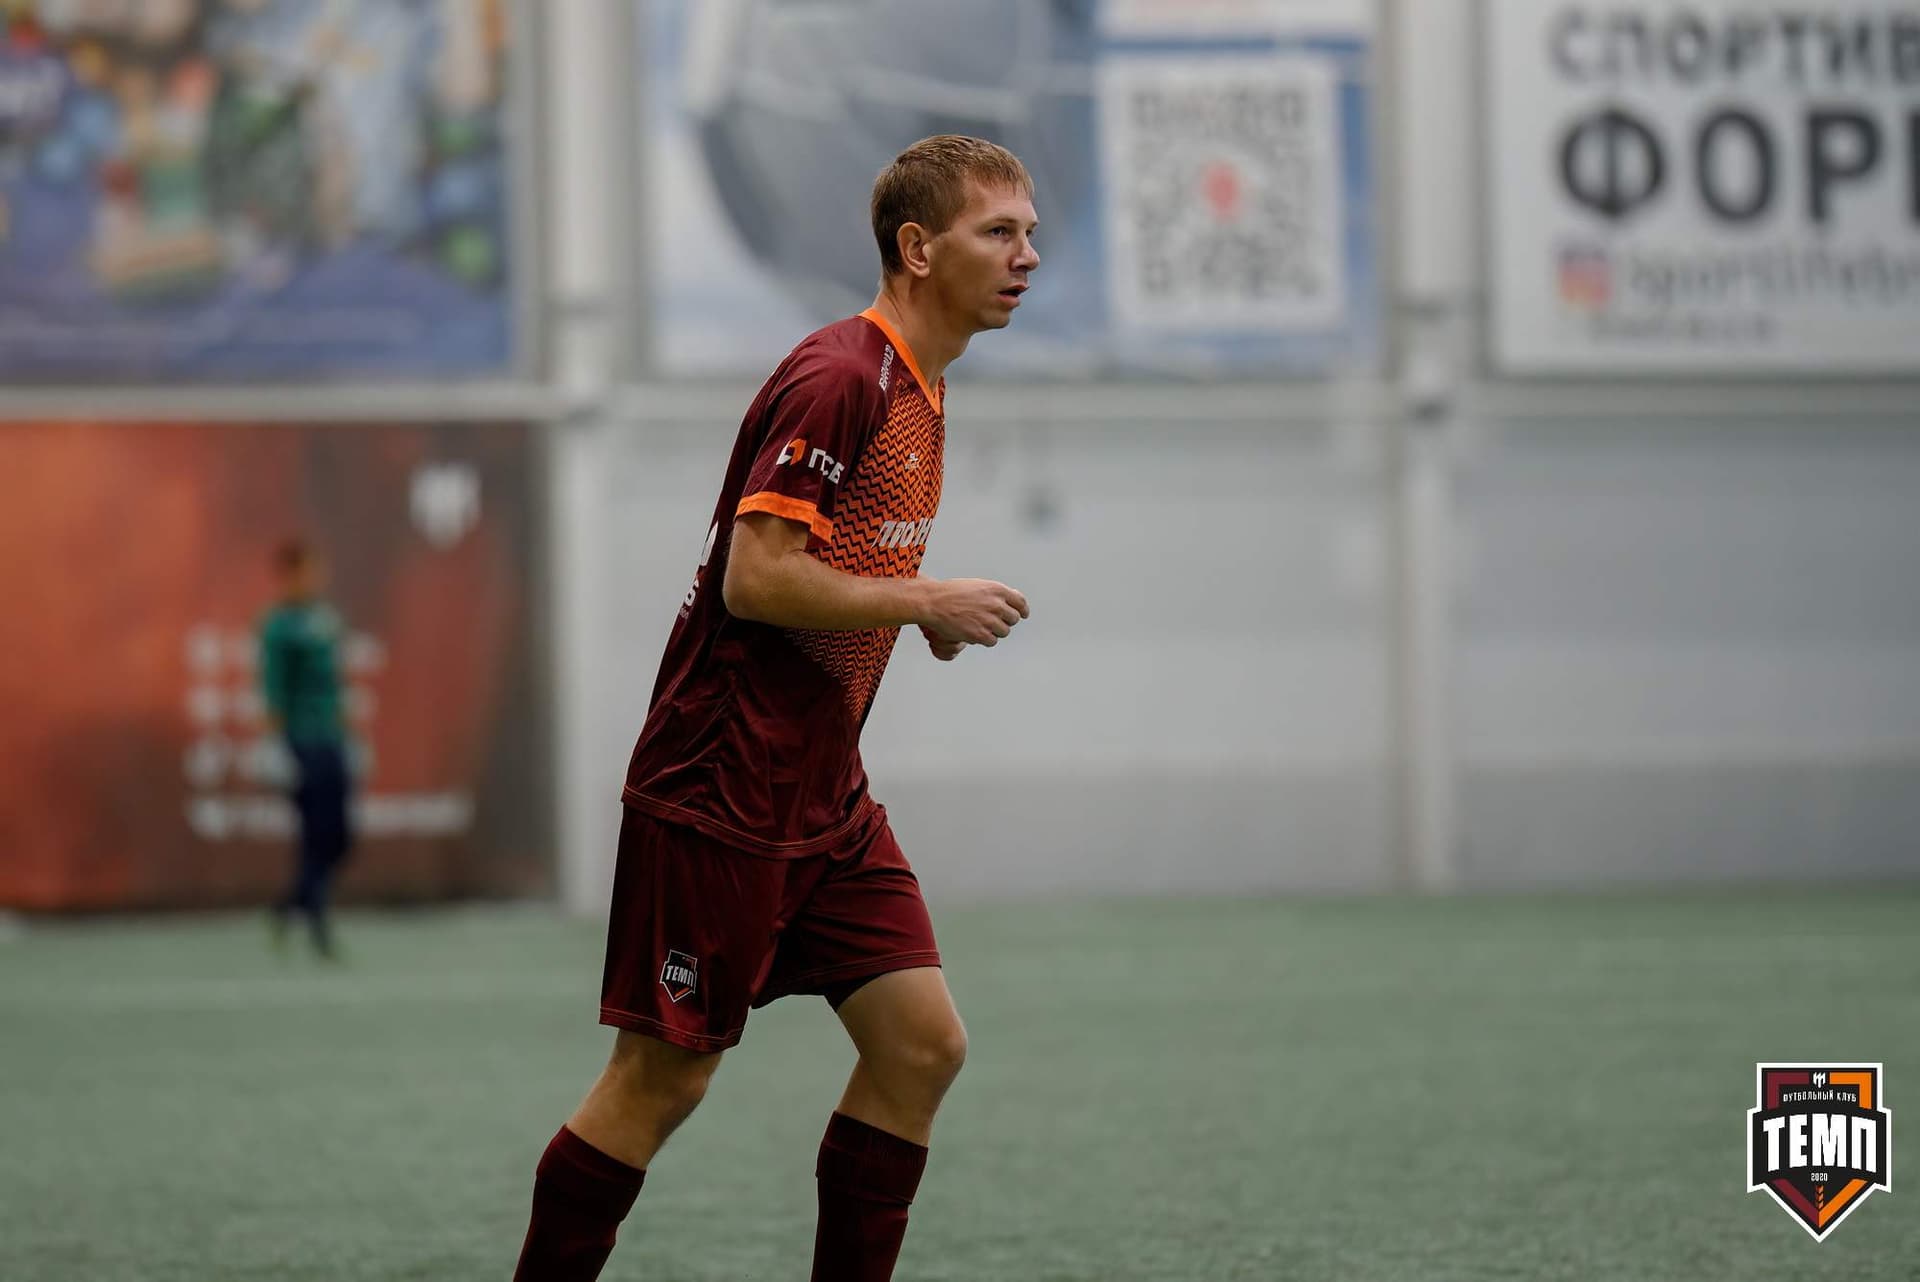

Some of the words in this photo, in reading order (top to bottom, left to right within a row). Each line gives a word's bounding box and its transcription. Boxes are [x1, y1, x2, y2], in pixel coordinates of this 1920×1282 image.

[1560, 108, 1920, 223] ФОР
[808, 448, 845, 484] ПСБ
[666, 965, 694, 987] ТЕМП
